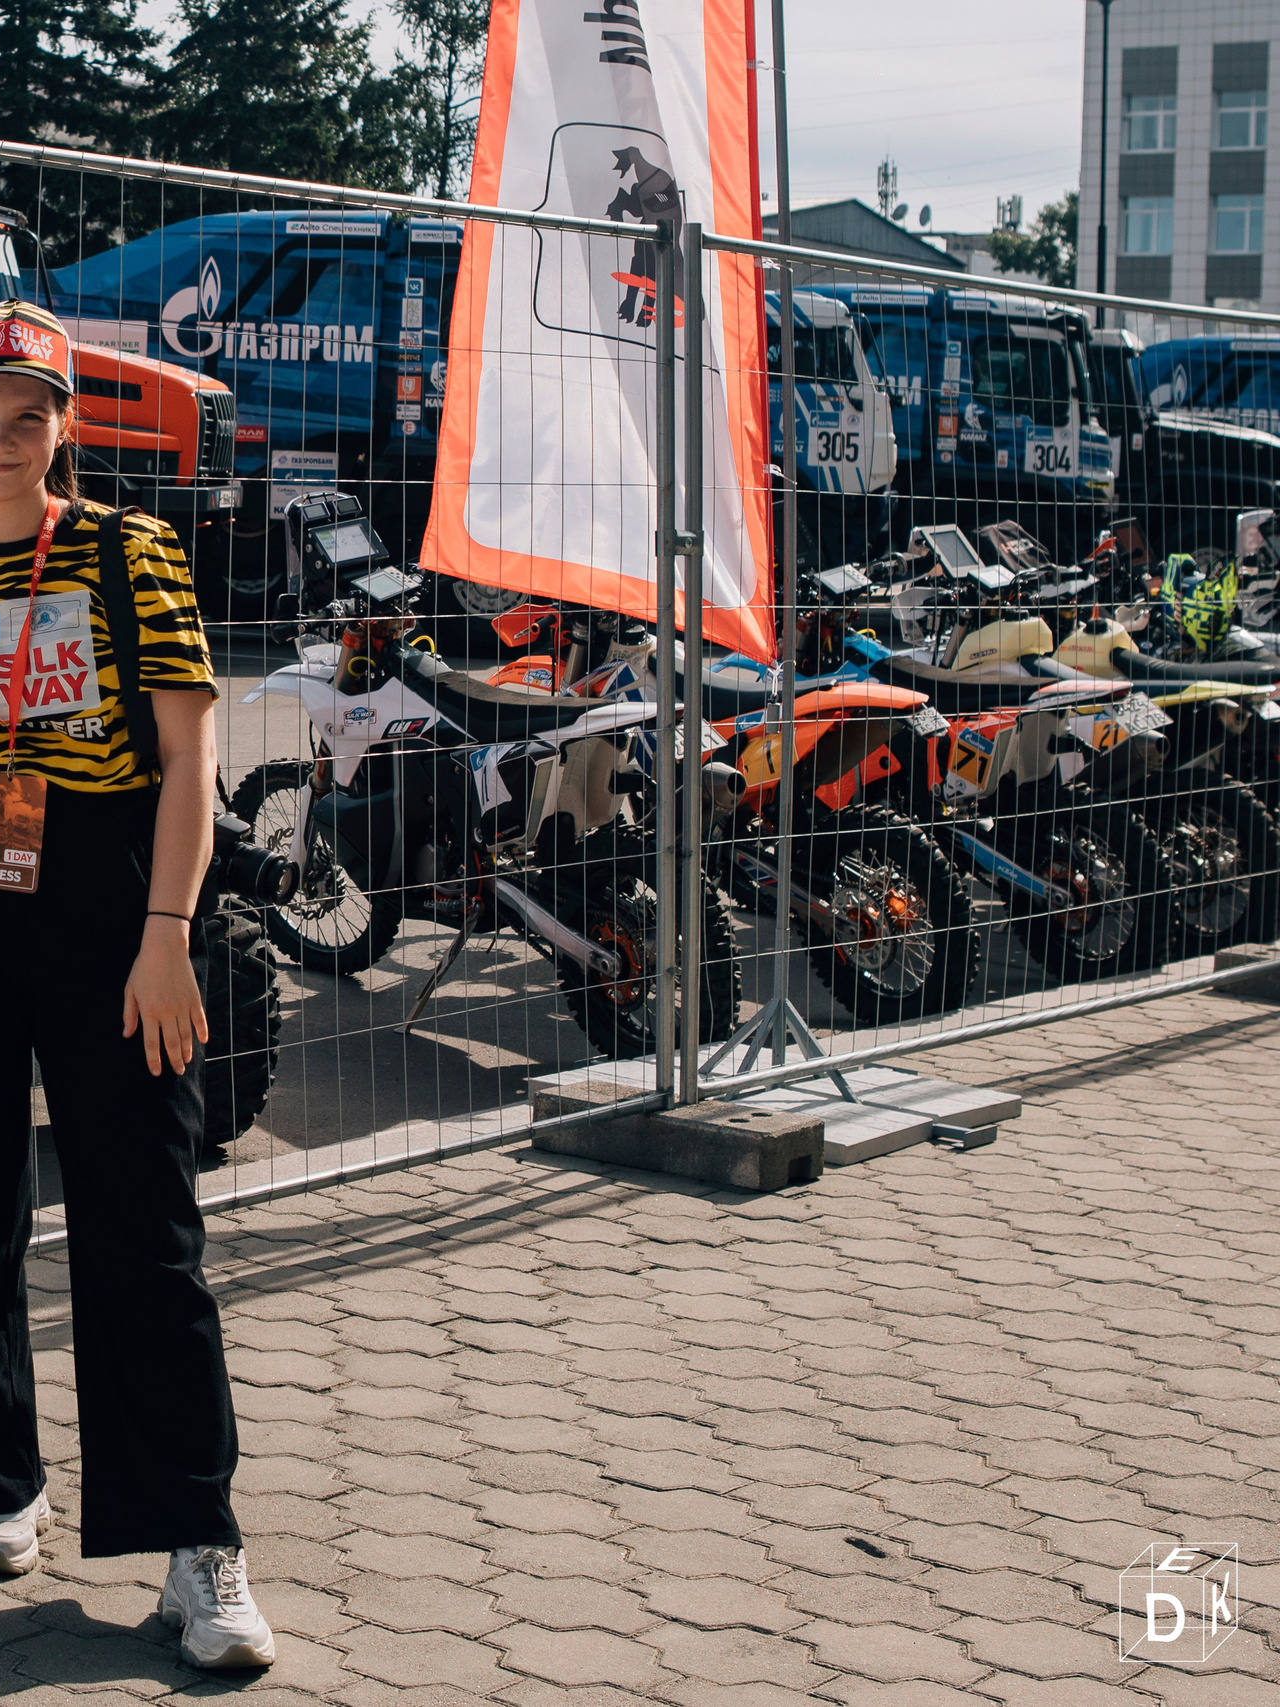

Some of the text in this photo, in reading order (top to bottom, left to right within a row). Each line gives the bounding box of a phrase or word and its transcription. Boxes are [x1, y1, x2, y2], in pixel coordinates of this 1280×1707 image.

[9, 323, 54, 347] SILK
[98, 340, 141, 349] PARTNER
[224, 322, 374, 363] ГАЗПРОМ
[9, 338, 55, 361] WAY
[774, 444, 805, 453] KAAZ
[818, 431, 860, 463] 305
[1033, 444, 1071, 473] 304
[952, 743, 989, 785] 71
[14, 852, 34, 863] DAY
